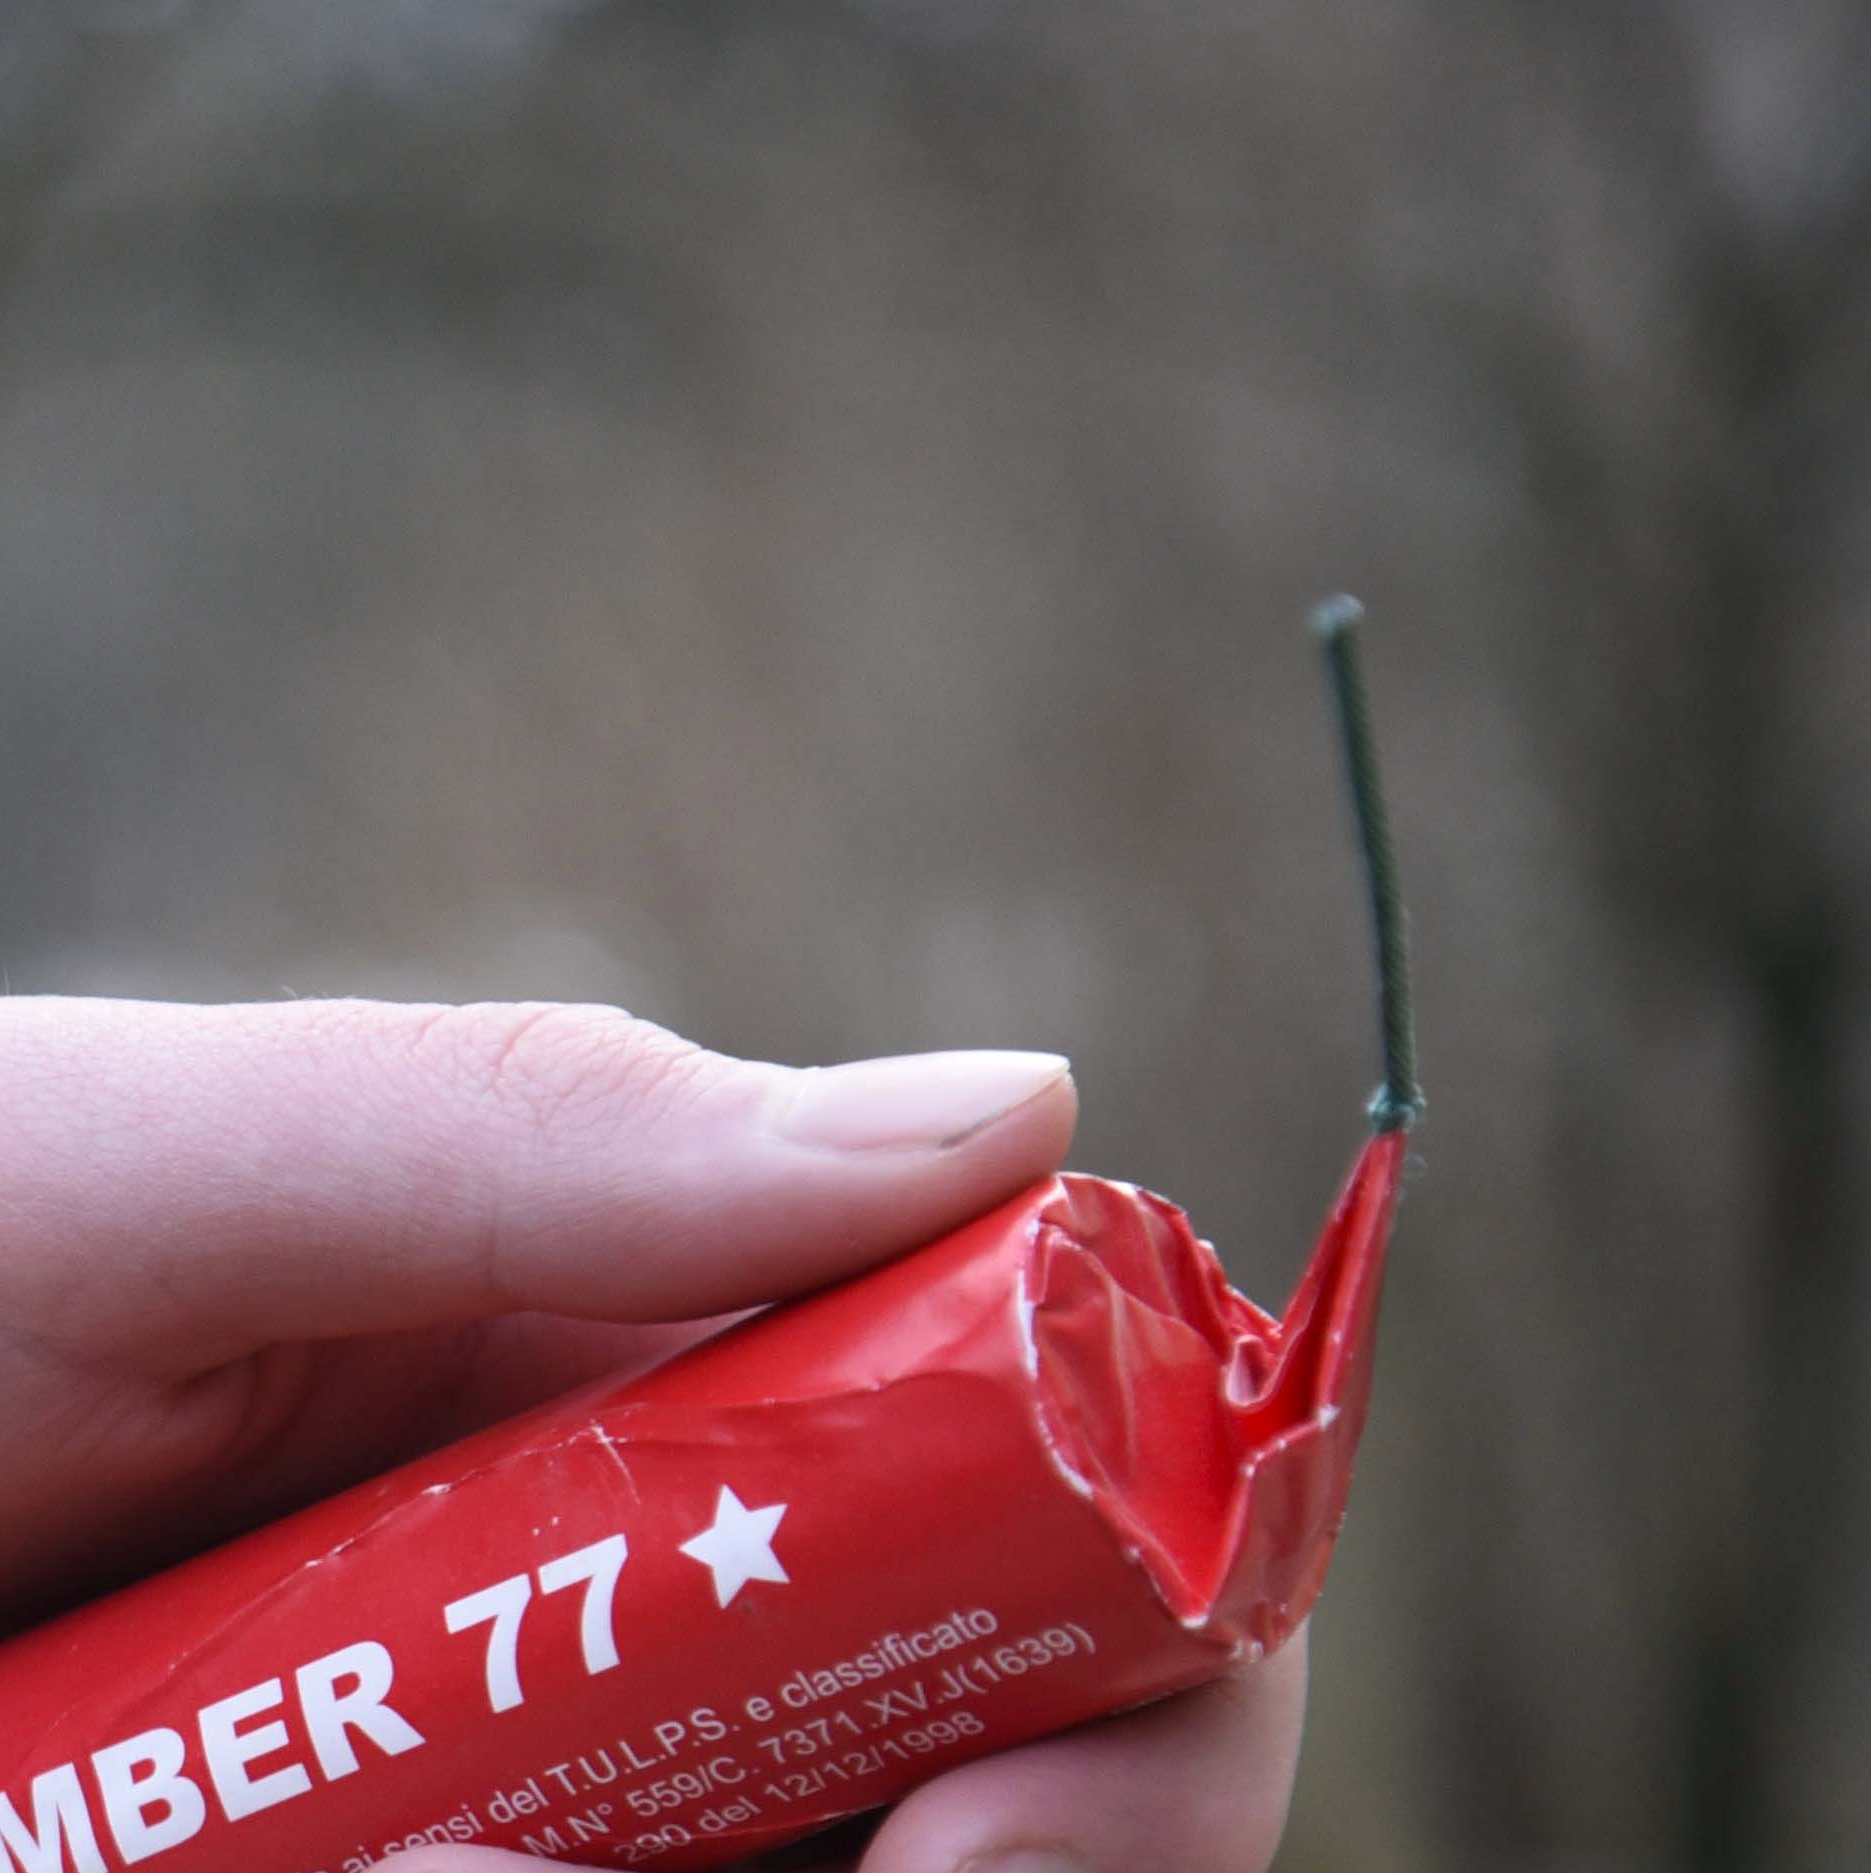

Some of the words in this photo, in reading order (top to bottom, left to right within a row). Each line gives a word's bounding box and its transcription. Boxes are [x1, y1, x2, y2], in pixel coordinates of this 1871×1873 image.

[444, 1533, 628, 1714] 77
[488, 1777, 548, 1825] del
[544, 1708, 740, 1797] T.U.L.P.S.
[746, 1696, 775, 1722] e
[780, 1608, 998, 1709] classificato
[699, 1796, 761, 1832] del
[765, 1711, 985, 1802] 12/12/1998
